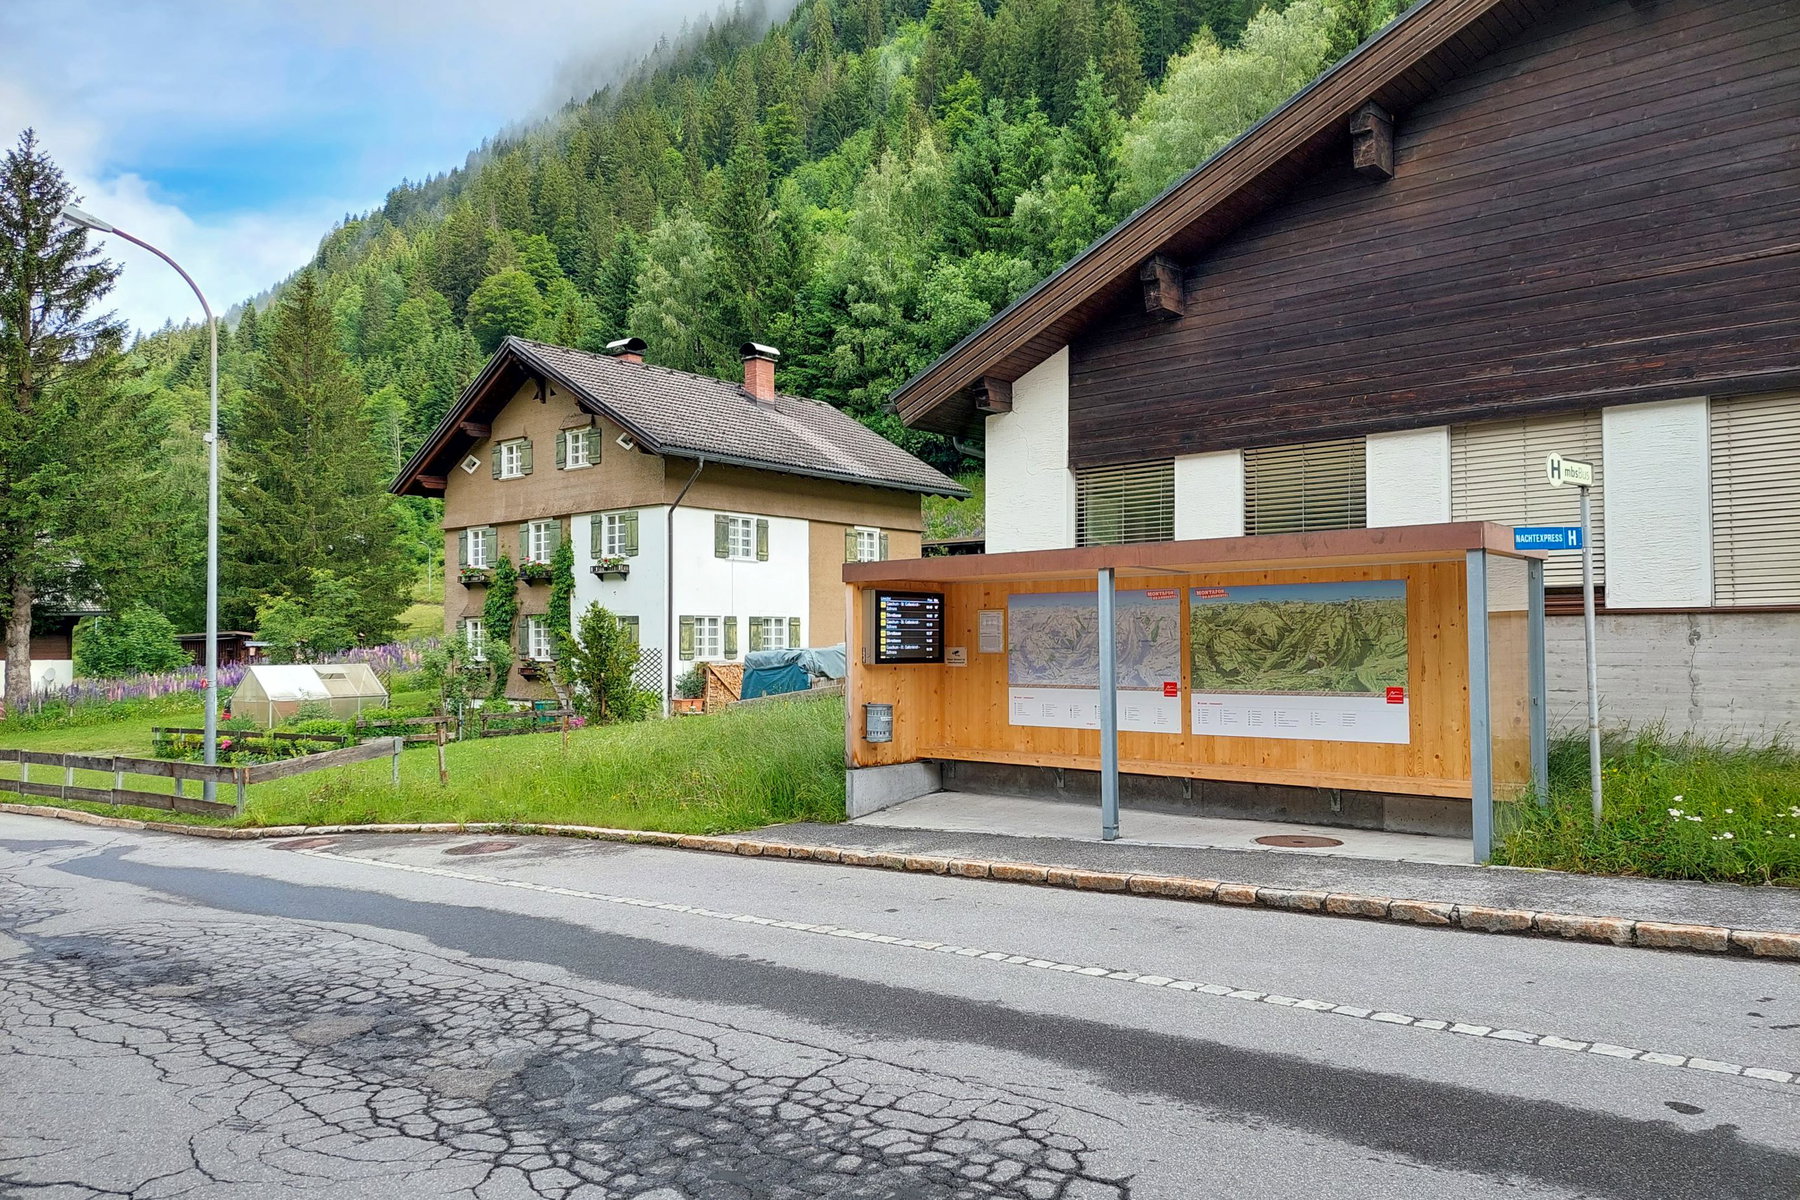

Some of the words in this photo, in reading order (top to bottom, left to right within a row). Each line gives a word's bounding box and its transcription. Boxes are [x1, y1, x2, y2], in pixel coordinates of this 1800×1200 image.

[1551, 459, 1561, 479] H
[1564, 466, 1590, 480] mbsBus
[1515, 534, 1563, 543] NACHTEXPRESS
[1568, 530, 1577, 546] H
